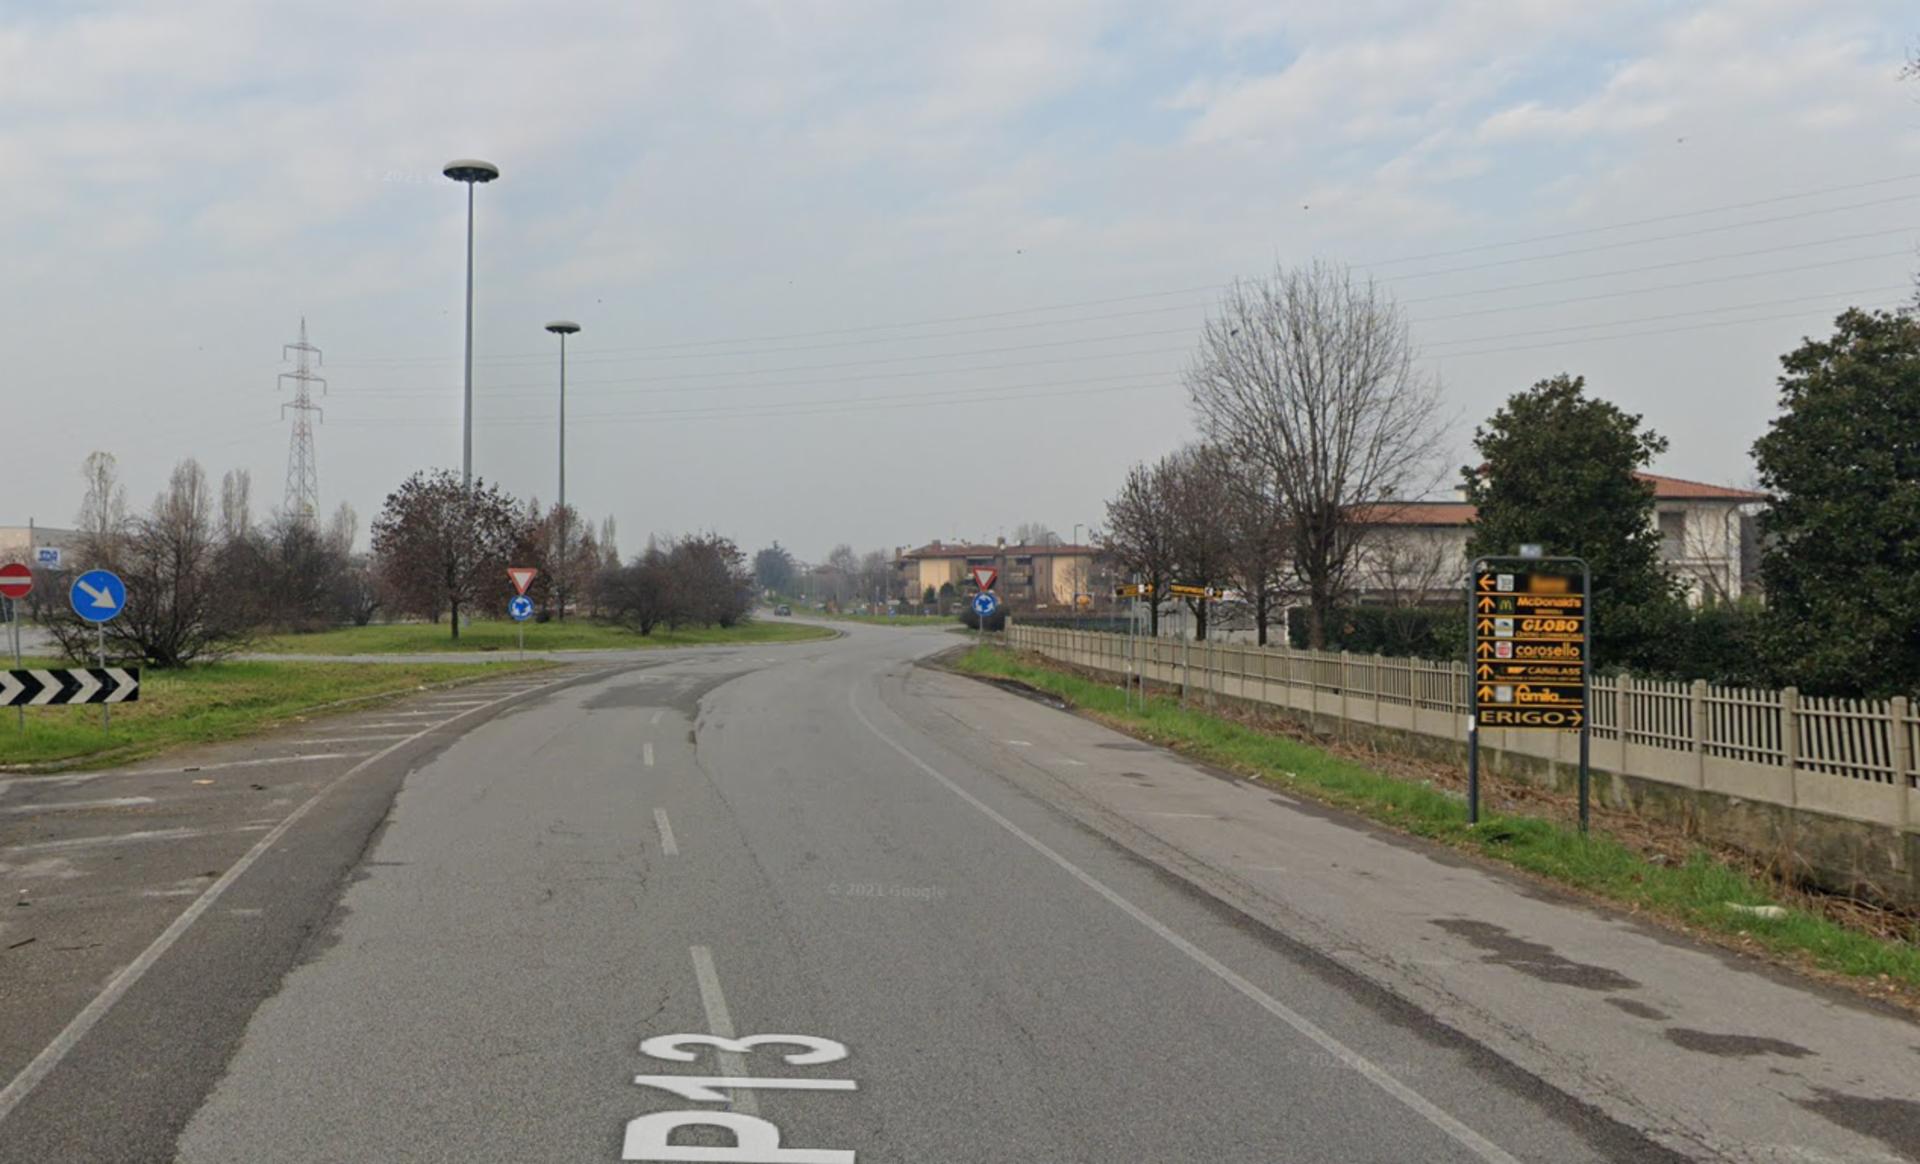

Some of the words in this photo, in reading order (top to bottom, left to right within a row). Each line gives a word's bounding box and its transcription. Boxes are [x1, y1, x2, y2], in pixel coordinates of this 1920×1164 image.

[1522, 619, 1579, 632] GLOBO
[1515, 641, 1580, 657] carosello
[1480, 711, 1564, 725] ERIGO
